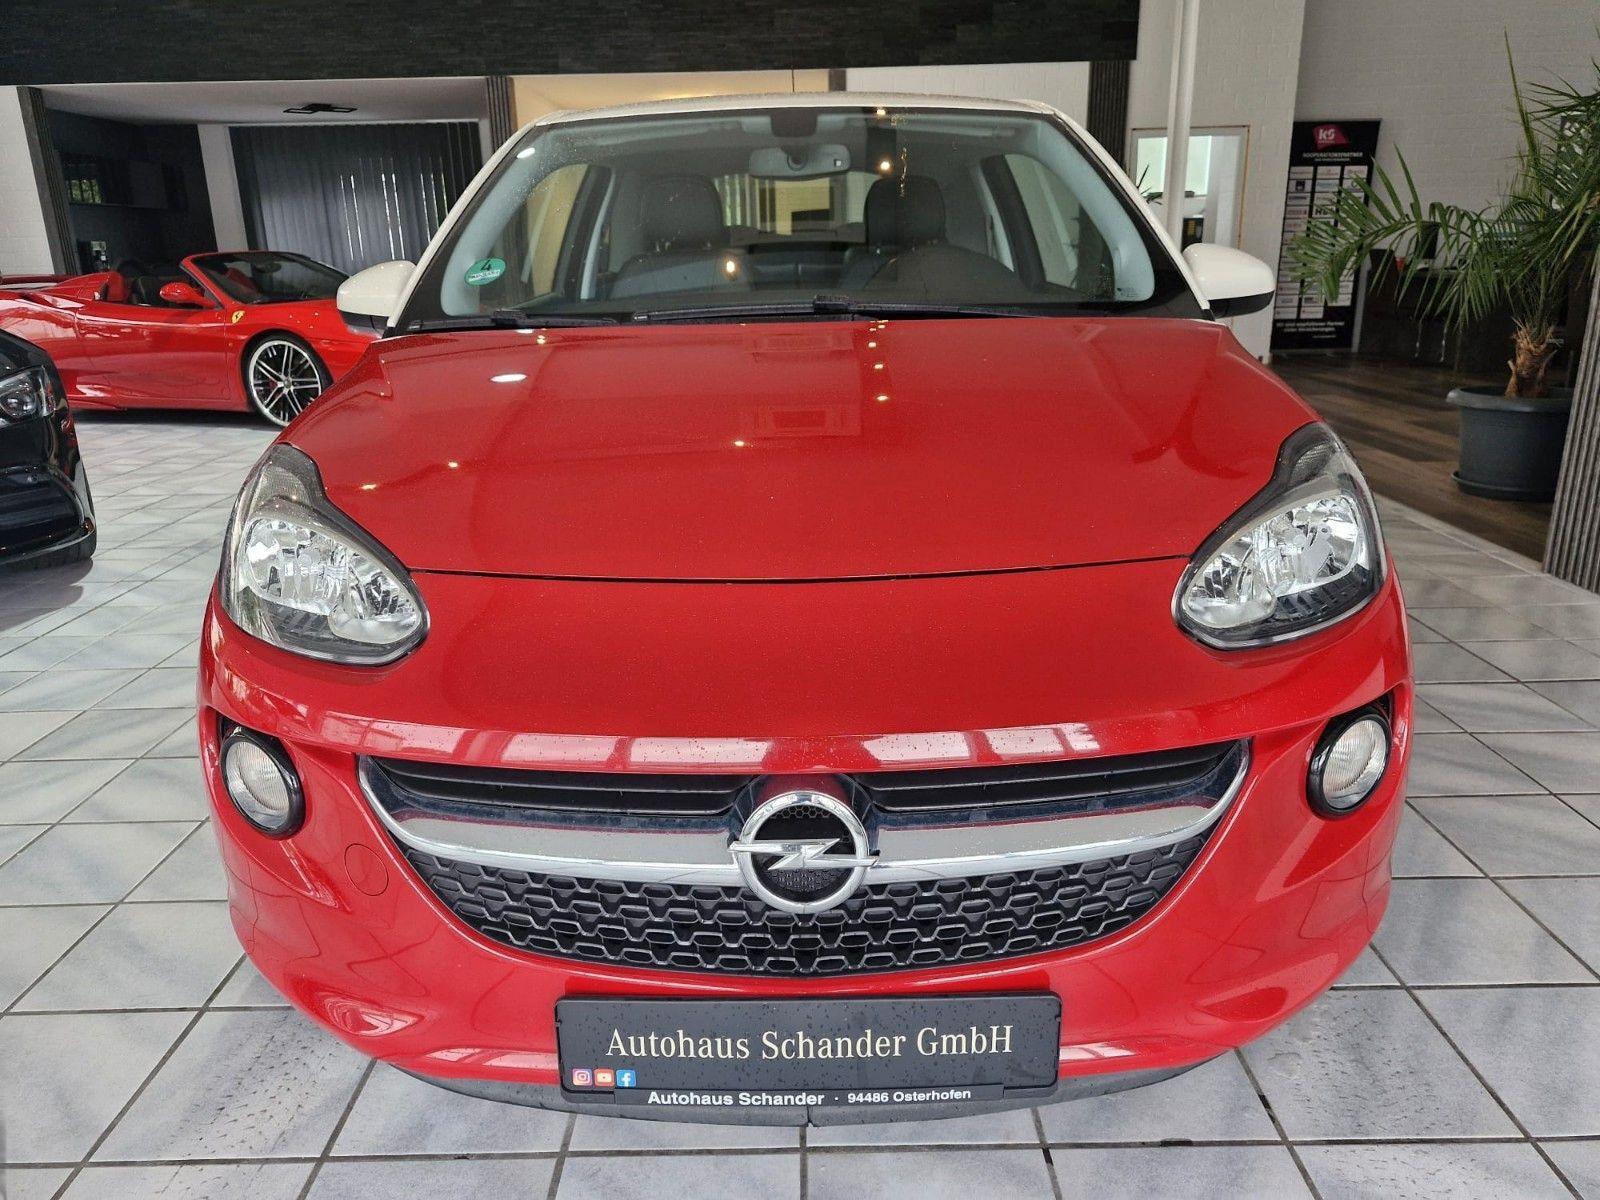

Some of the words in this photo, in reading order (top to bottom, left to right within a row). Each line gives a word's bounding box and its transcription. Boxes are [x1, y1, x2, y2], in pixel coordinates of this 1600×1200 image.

[605, 1028, 750, 1059] Autohaus
[761, 1028, 907, 1061] Schander
[916, 1025, 1014, 1056] GmbH
[647, 1091, 734, 1106] Autohaus
[738, 1091, 825, 1106] Schander
[847, 1092, 889, 1104] 94486
[892, 1089, 972, 1103] Osterhofen
